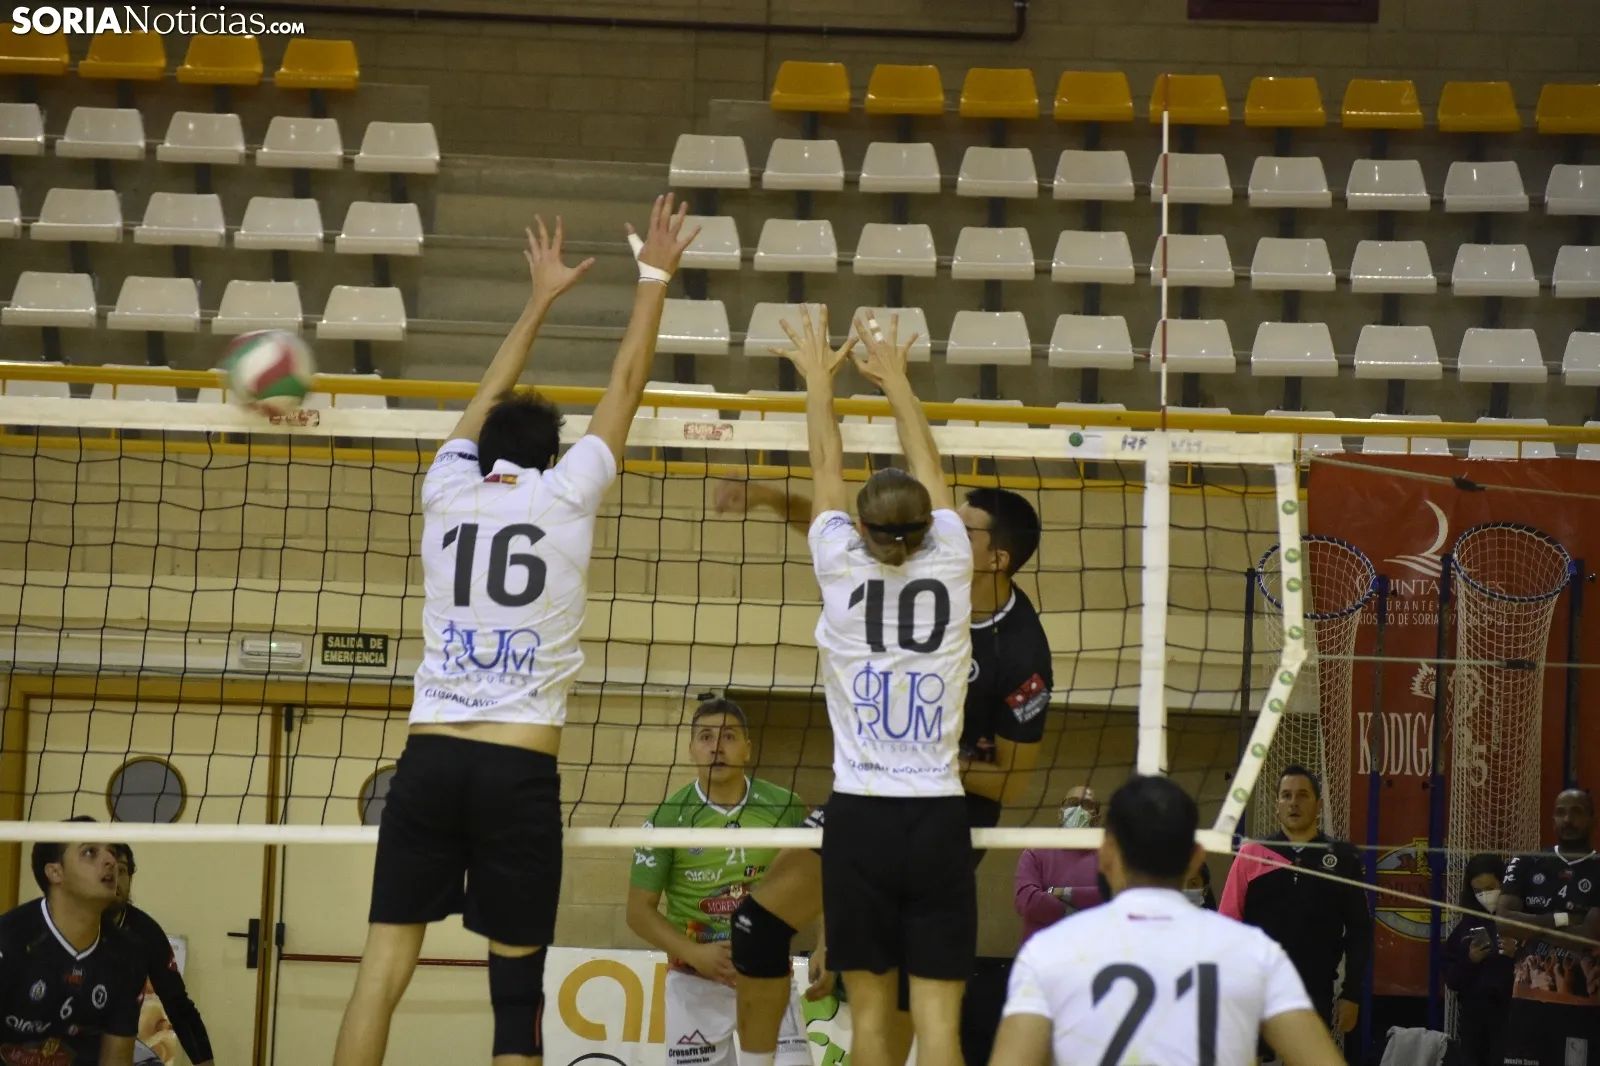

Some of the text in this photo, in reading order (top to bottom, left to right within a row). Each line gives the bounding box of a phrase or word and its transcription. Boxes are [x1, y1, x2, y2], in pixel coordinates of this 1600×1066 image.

[442, 522, 547, 607] 16
[848, 578, 950, 653] 10
[1398, 613, 1409, 625] DE
[1412, 613, 1440, 625] SORIA
[327, 635, 384, 649] SALIDA DE
[726, 847, 745, 865] 21
[1557, 884, 1568, 899] 4
[60, 996, 74, 1020] 6
[1091, 962, 1219, 1066] 21
